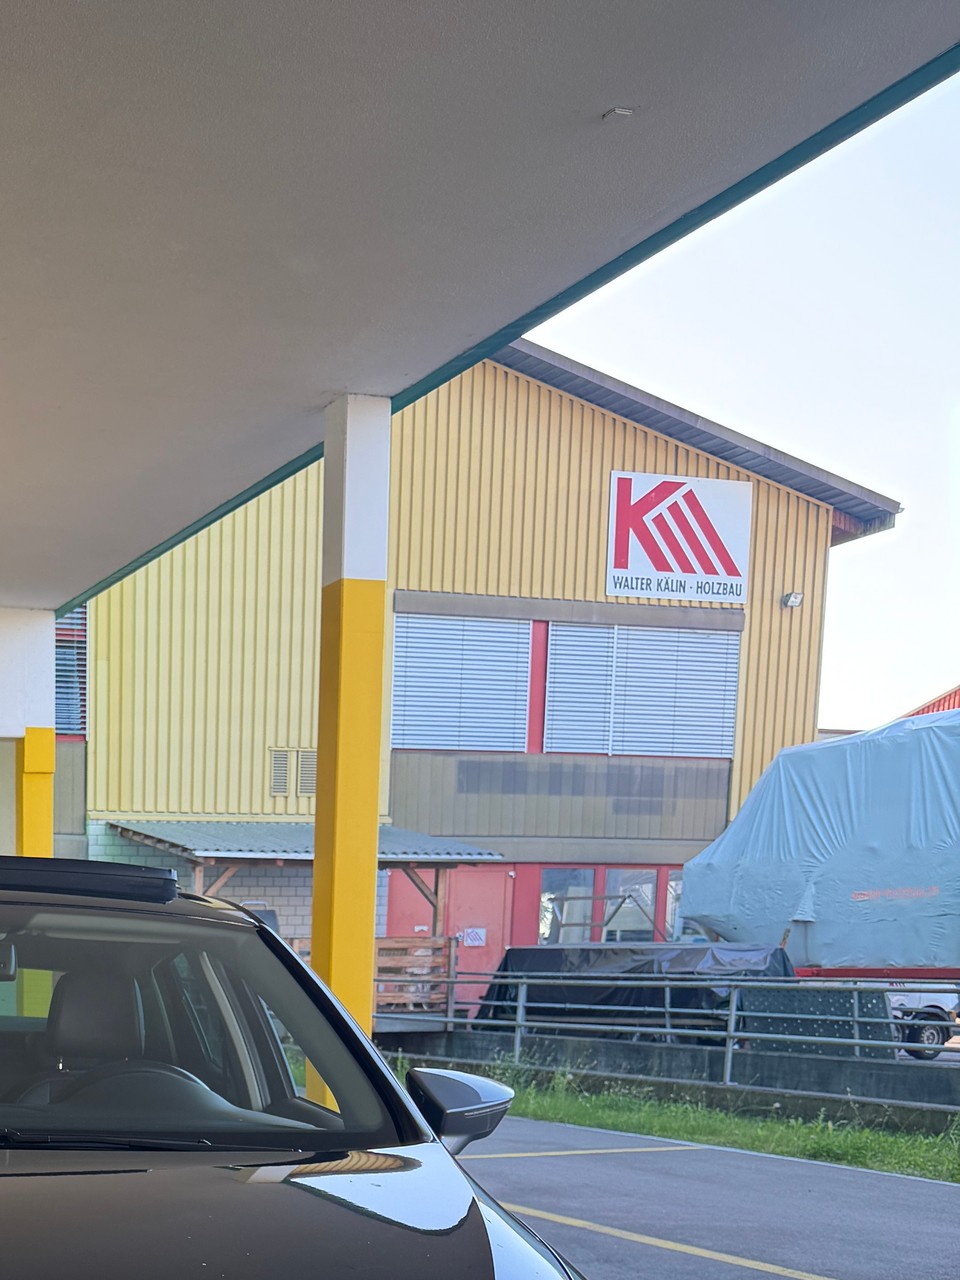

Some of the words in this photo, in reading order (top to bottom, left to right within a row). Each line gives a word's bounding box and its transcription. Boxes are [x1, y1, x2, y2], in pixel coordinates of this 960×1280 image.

[613, 575, 652, 591] WALTER
[656, 577, 686, 593] KÄLIN
[696, 581, 742, 596] HOLZBAU
